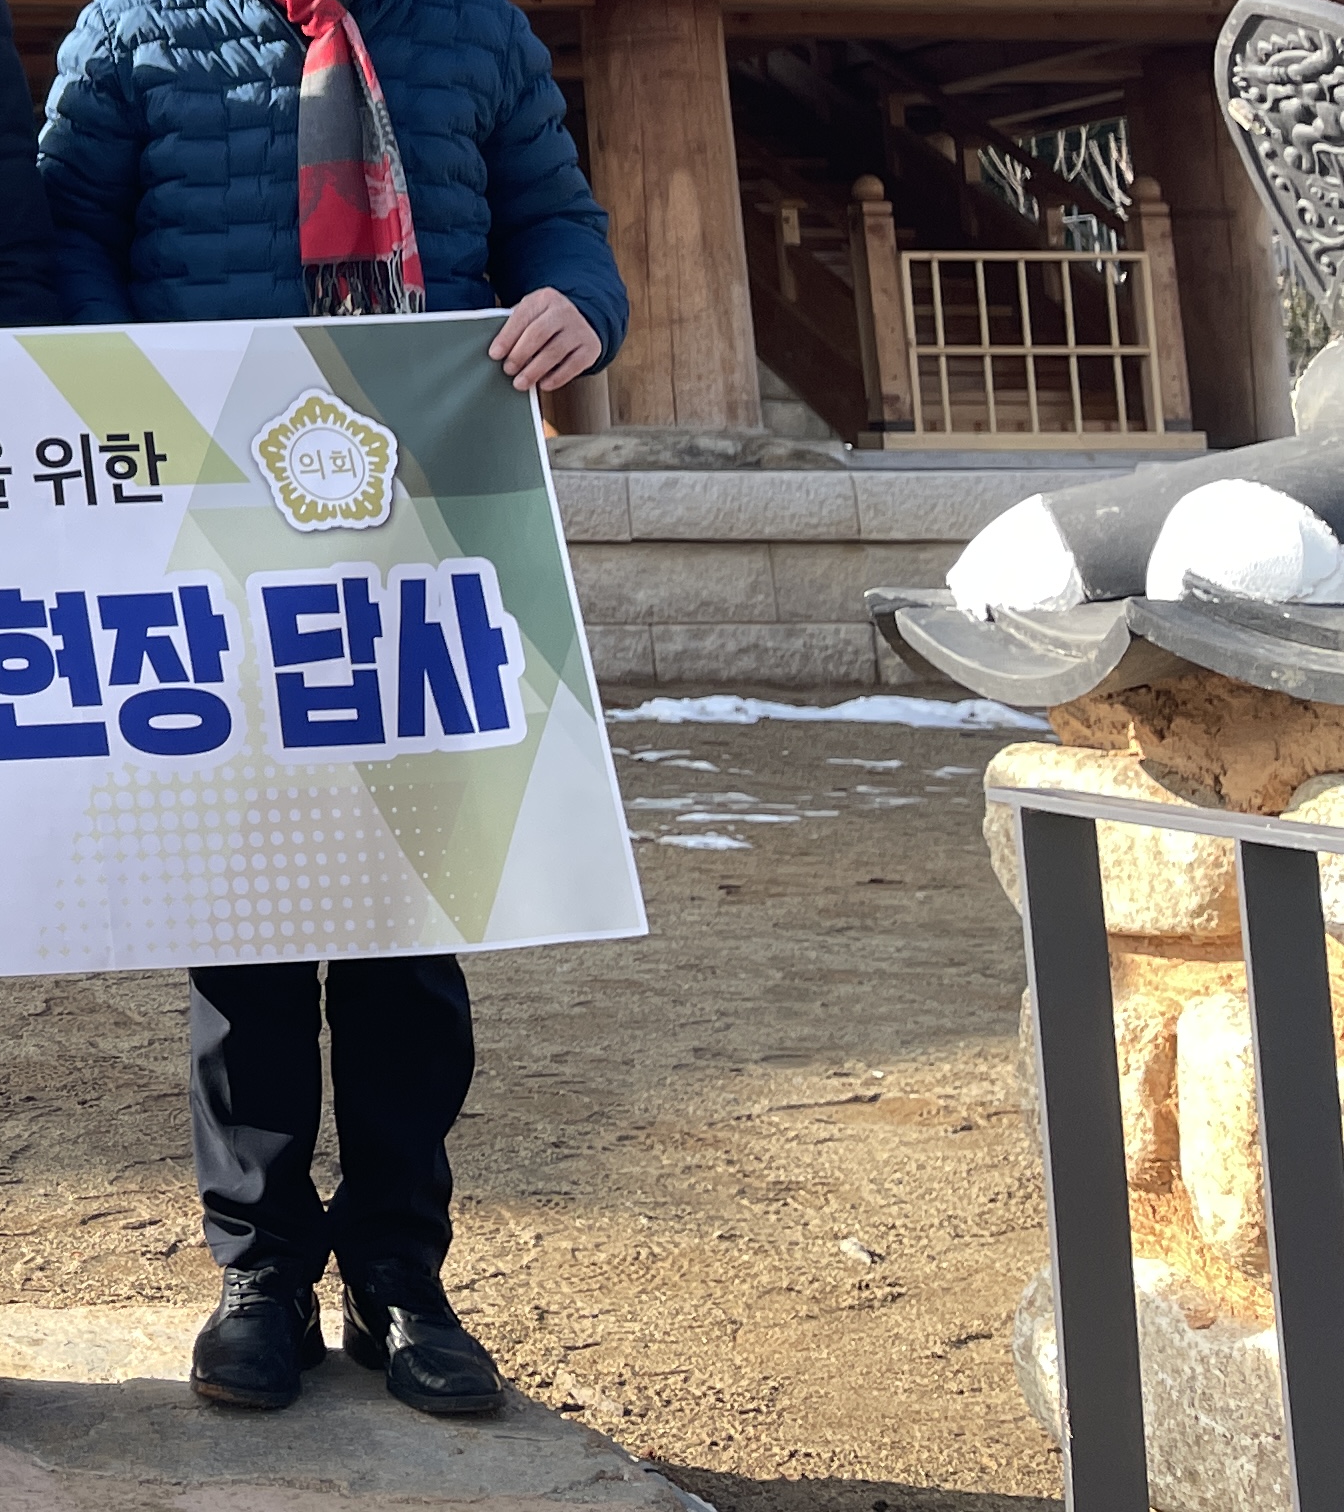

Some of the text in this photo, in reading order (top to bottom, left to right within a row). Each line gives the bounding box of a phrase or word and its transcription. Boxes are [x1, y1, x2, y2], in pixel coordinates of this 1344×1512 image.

[33, 431, 168, 506] 위한
[298, 447, 358, 481] 의회
[258, 573, 511, 750] 답사
